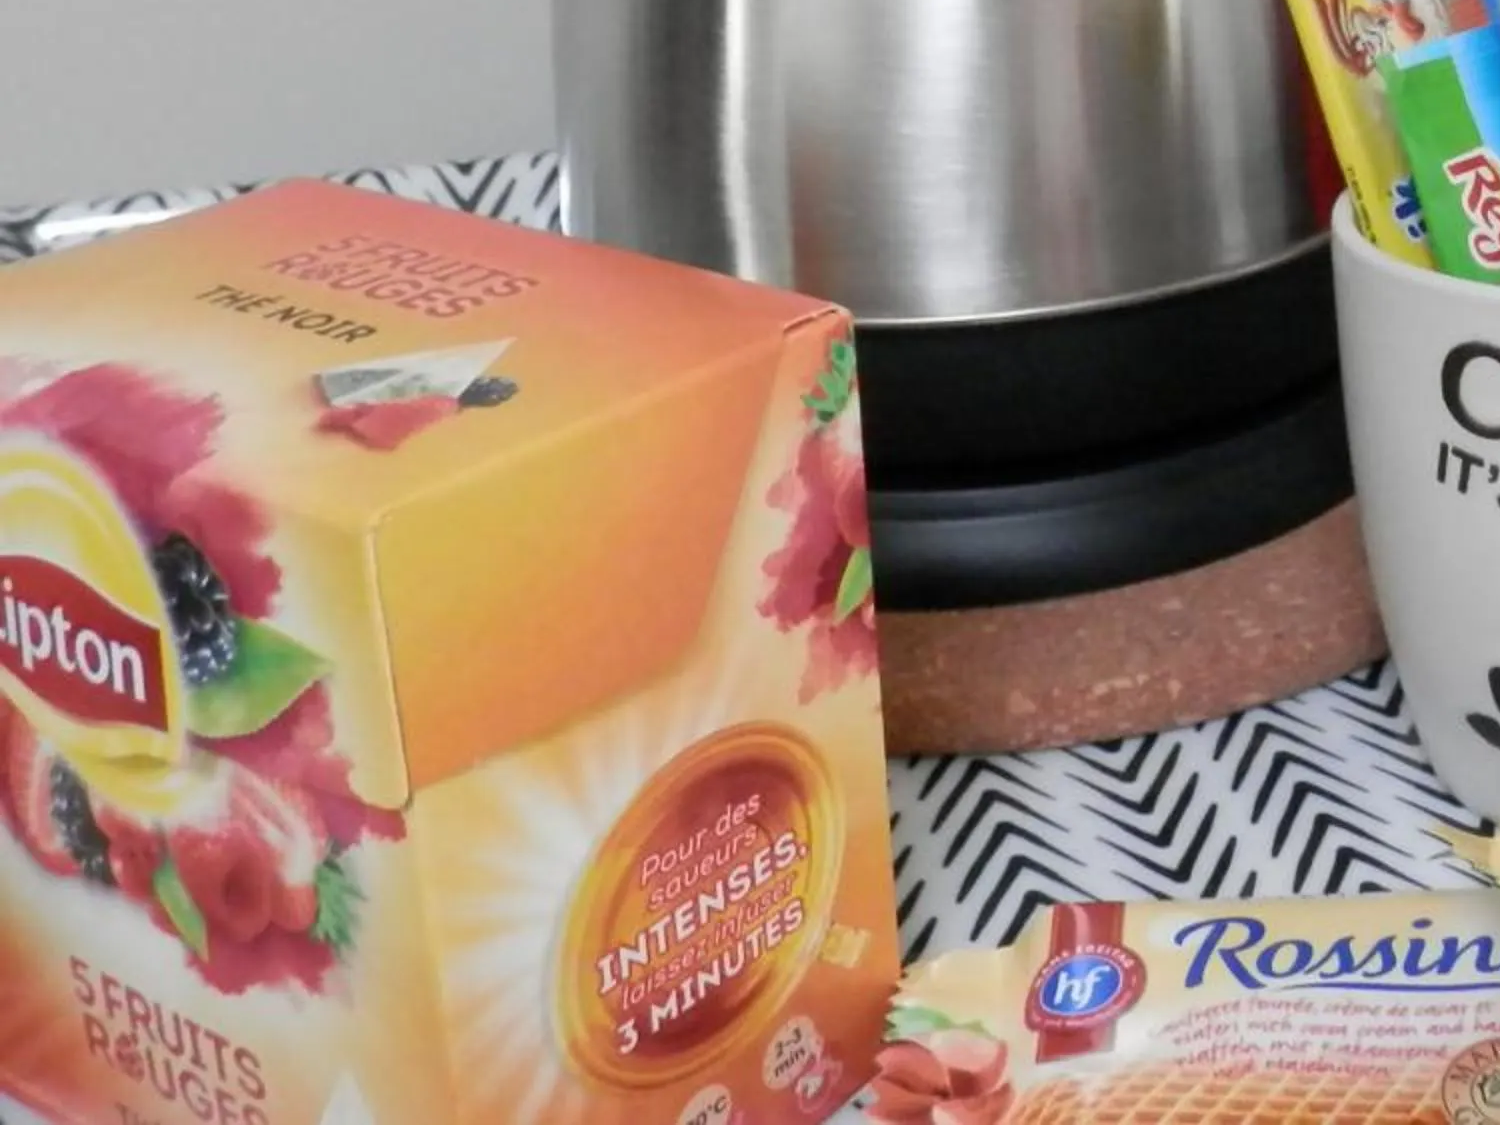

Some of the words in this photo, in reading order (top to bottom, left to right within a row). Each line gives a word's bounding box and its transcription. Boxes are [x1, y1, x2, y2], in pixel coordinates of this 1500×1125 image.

[345, 241, 540, 298] FRUITS
[264, 305, 377, 344] NOIR
[0, 577, 147, 704] ipton
[640, 827, 708, 886] Pour
[715, 793, 761, 836] des
[649, 824, 760, 911] saveurs
[597, 831, 808, 995] INTENSES.
[617, 1019, 639, 1055] 3
[650, 899, 803, 1033] MINUTES
[1053, 965, 1112, 1011] hf
[70, 955, 97, 1007] 5
[101, 971, 267, 1101] FRUITS
